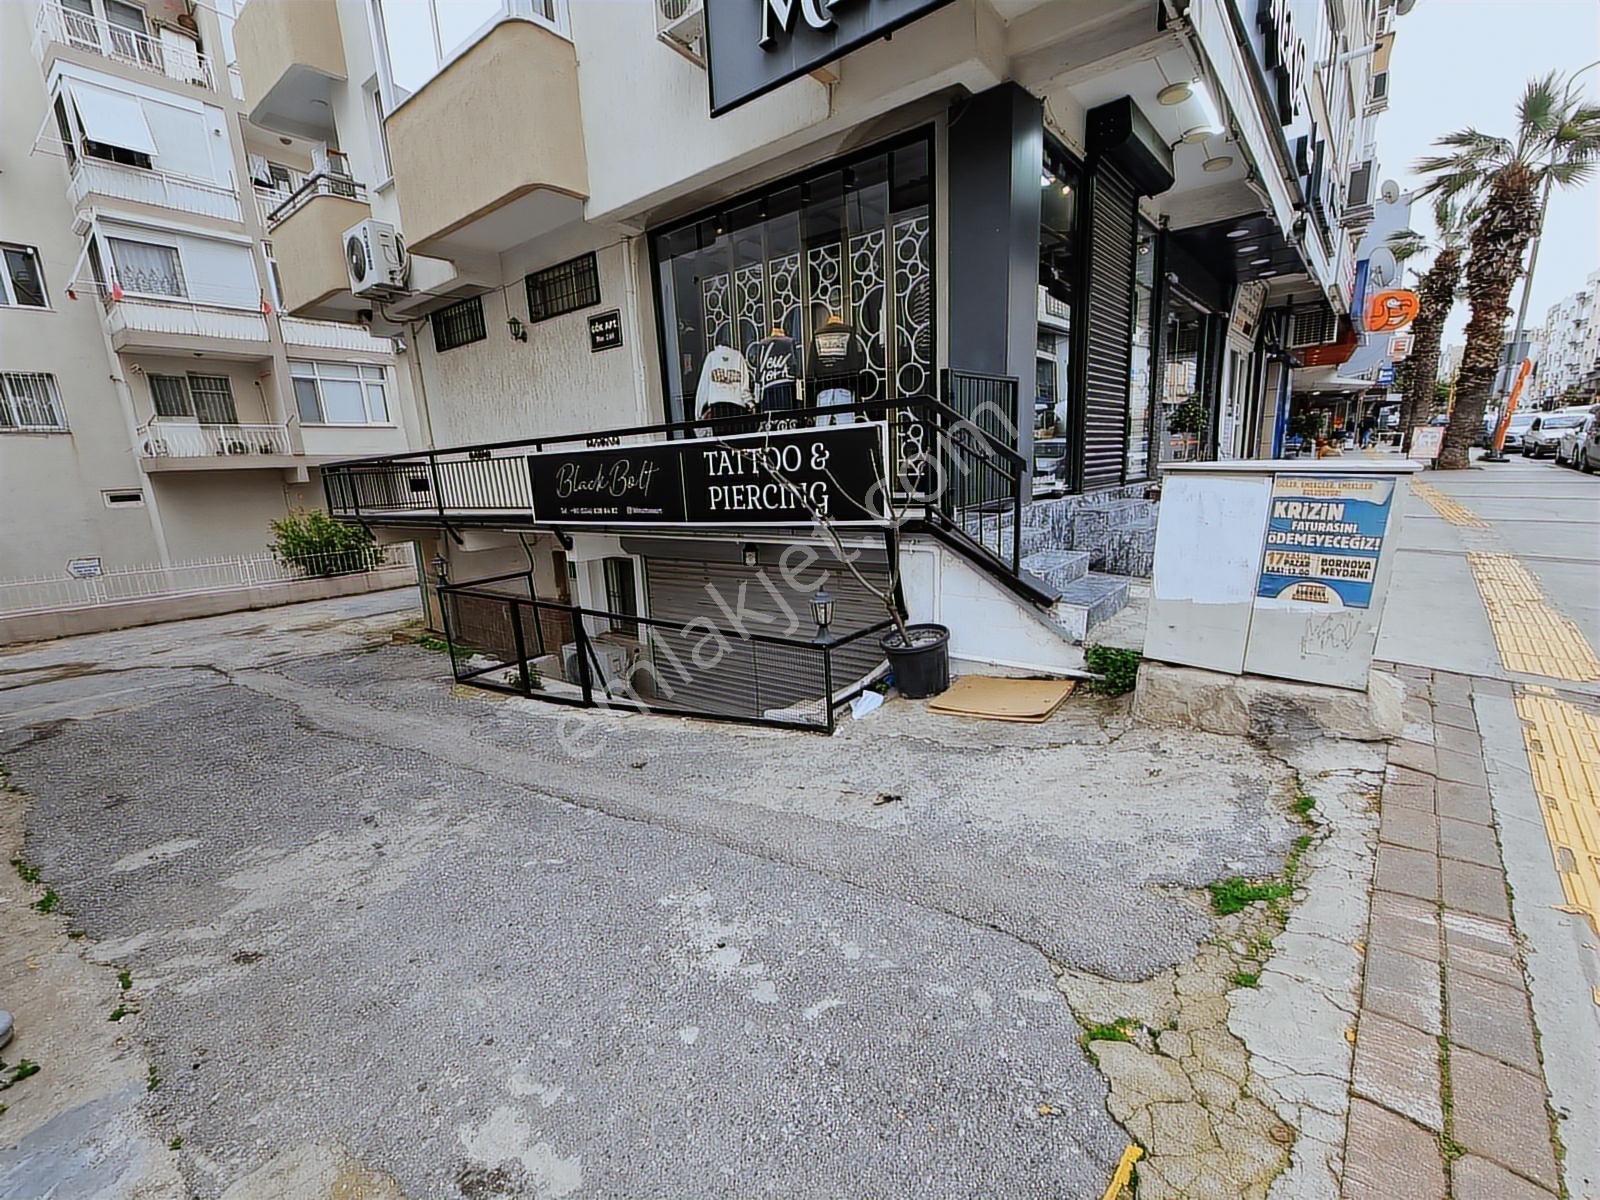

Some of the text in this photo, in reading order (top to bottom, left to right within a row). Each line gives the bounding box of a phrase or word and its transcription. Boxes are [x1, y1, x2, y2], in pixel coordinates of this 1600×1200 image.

[703, 442, 830, 477] TATTOO &
[555, 458, 660, 499] Black Bolt
[708, 481, 830, 518] PIERCING
[1274, 502, 1344, 520] KRİZİN
[1291, 521, 1358, 534] FATURASINI
[1268, 532, 1380, 550] ÖDEMEYECEĞİZ!
[1267, 552, 1285, 566] 17
[1284, 559, 1311, 567] PAZAR
[1320, 557, 1372, 570] BORNOVA
[1320, 567, 1369, 580] MEYDANI
